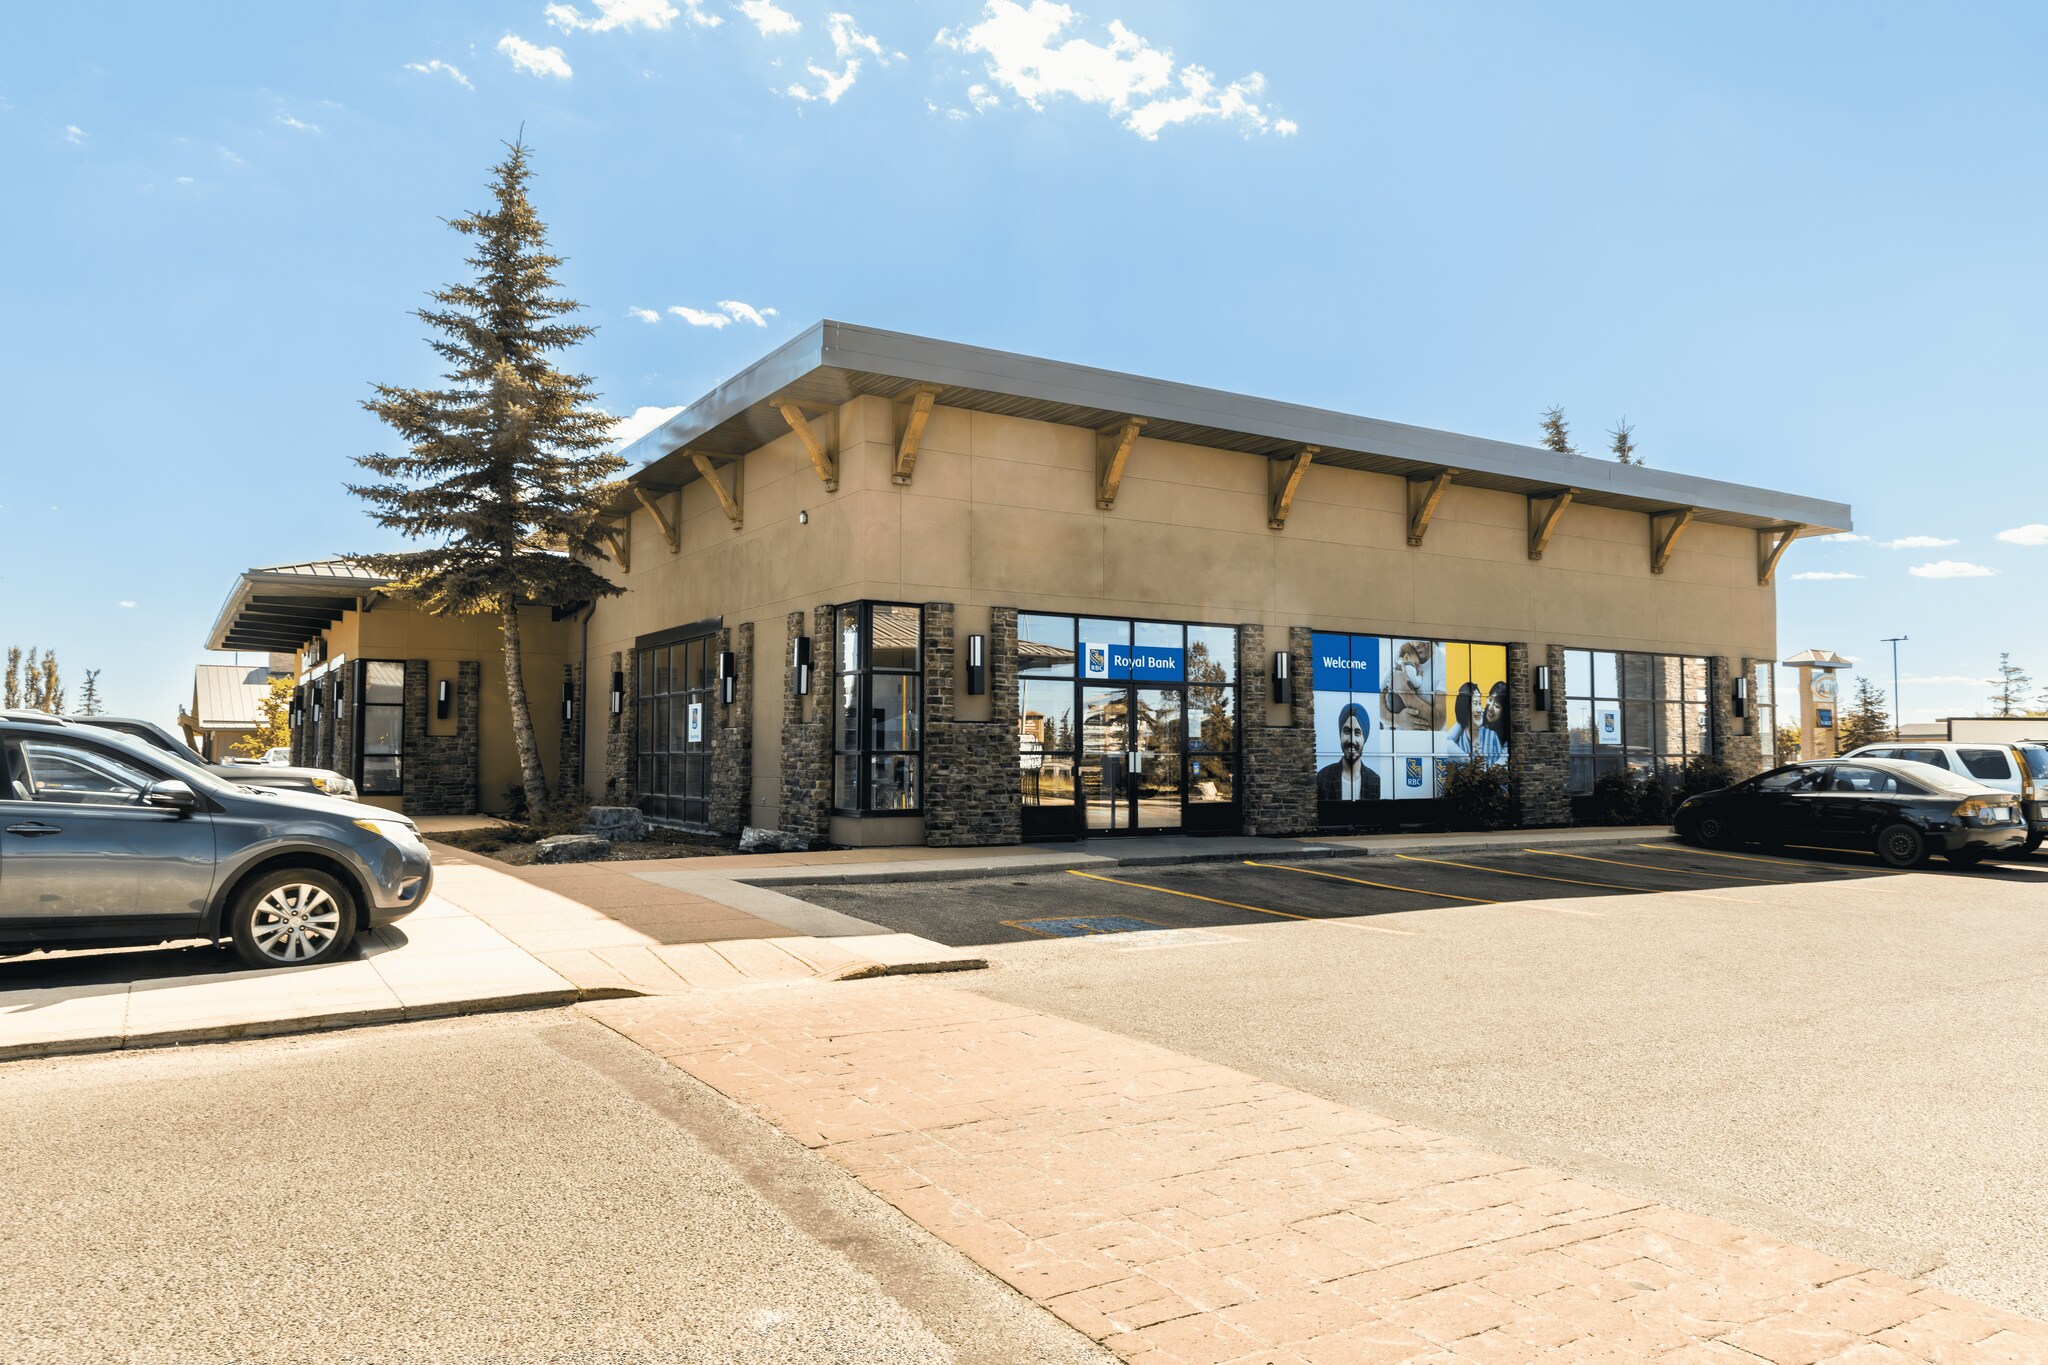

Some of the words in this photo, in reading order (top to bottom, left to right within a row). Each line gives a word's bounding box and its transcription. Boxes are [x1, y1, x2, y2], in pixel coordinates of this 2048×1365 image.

[1114, 655, 1145, 671] Royal
[1148, 656, 1176, 669] Bank
[1322, 656, 1367, 670] Welcome
[1407, 778, 1421, 786] RBC
